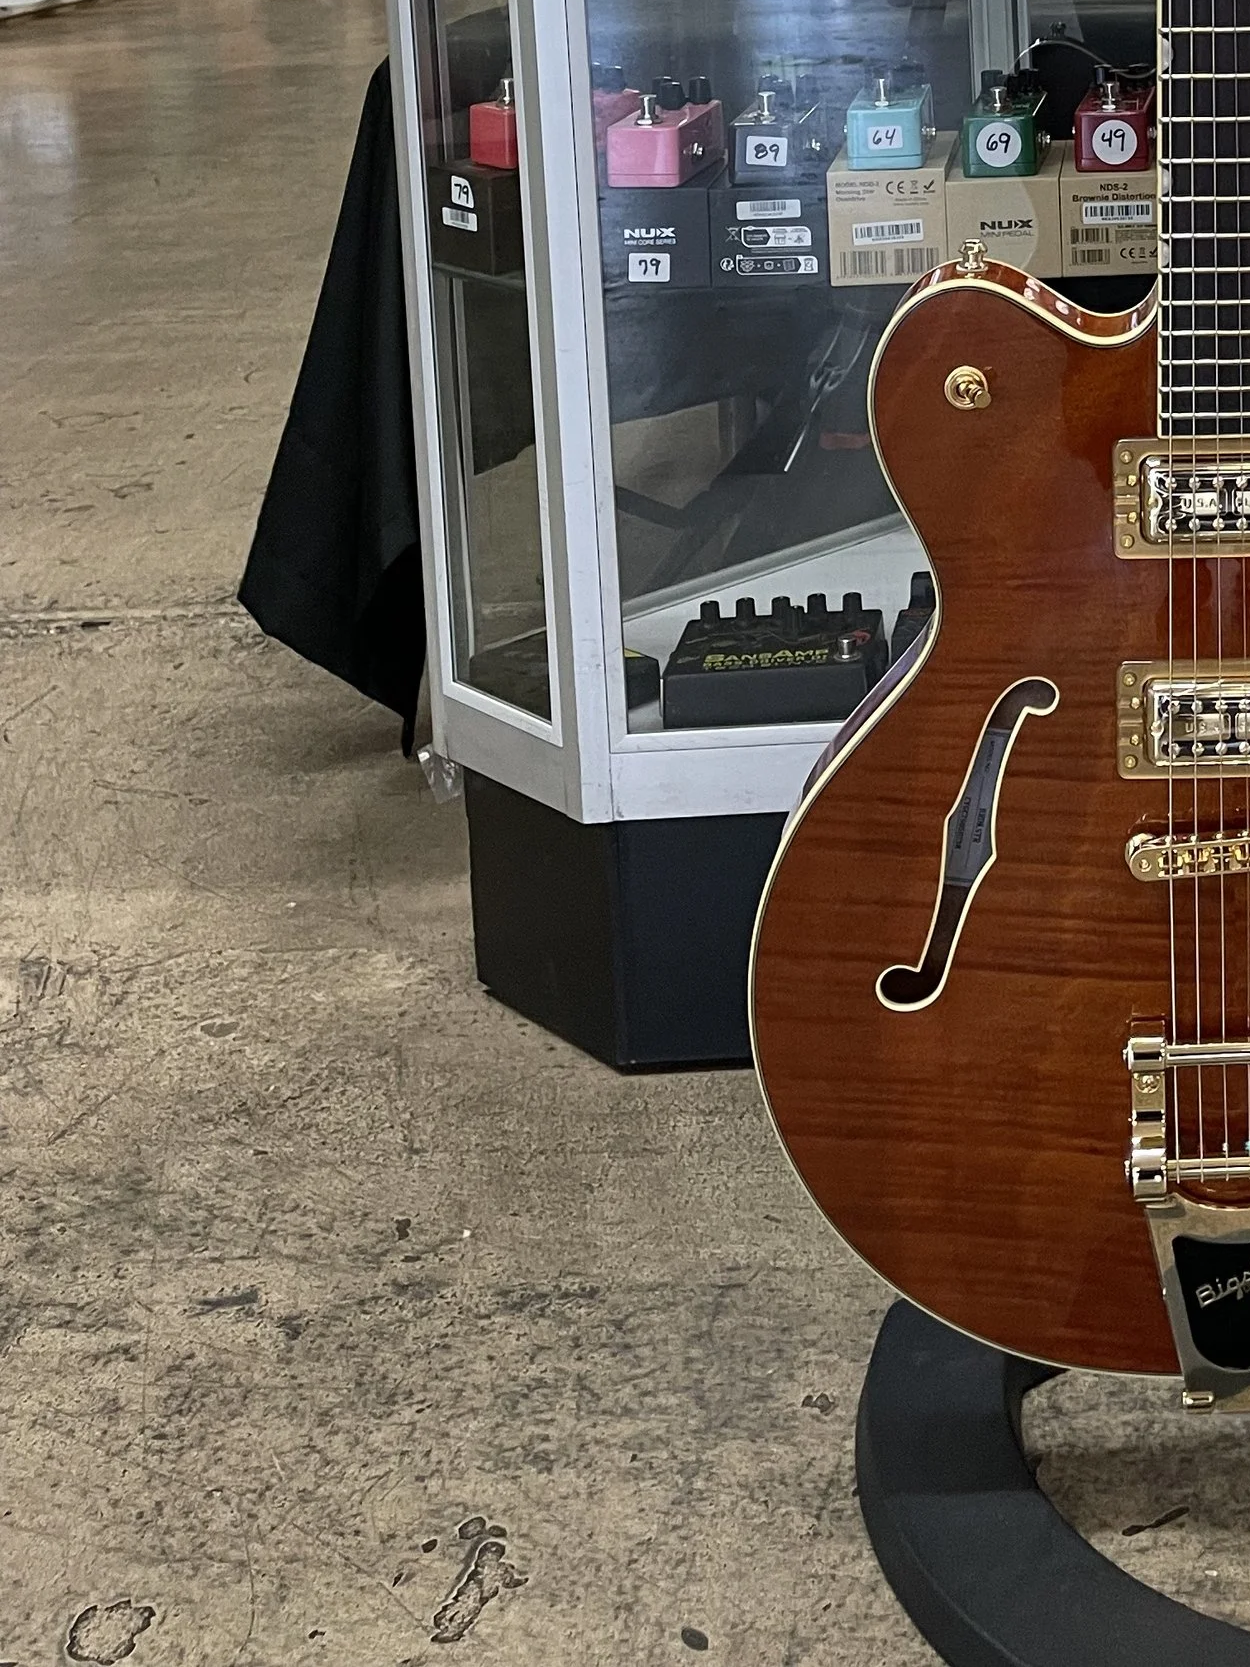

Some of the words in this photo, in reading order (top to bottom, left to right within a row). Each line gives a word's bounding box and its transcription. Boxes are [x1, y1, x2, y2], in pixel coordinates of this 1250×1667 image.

[872, 128, 897, 146] 64
[986, 132, 1011, 154] 69
[1101, 128, 1126, 152] 49
[753, 142, 780, 162] 89
[454, 183, 469, 205] 79
[1099, 183, 1128, 192] NDS-2
[1072, 194, 1109, 203] Brownie
[623, 227, 676, 239] NUX
[980, 219, 1034, 231] NUX
[638, 257, 662, 276] 79
